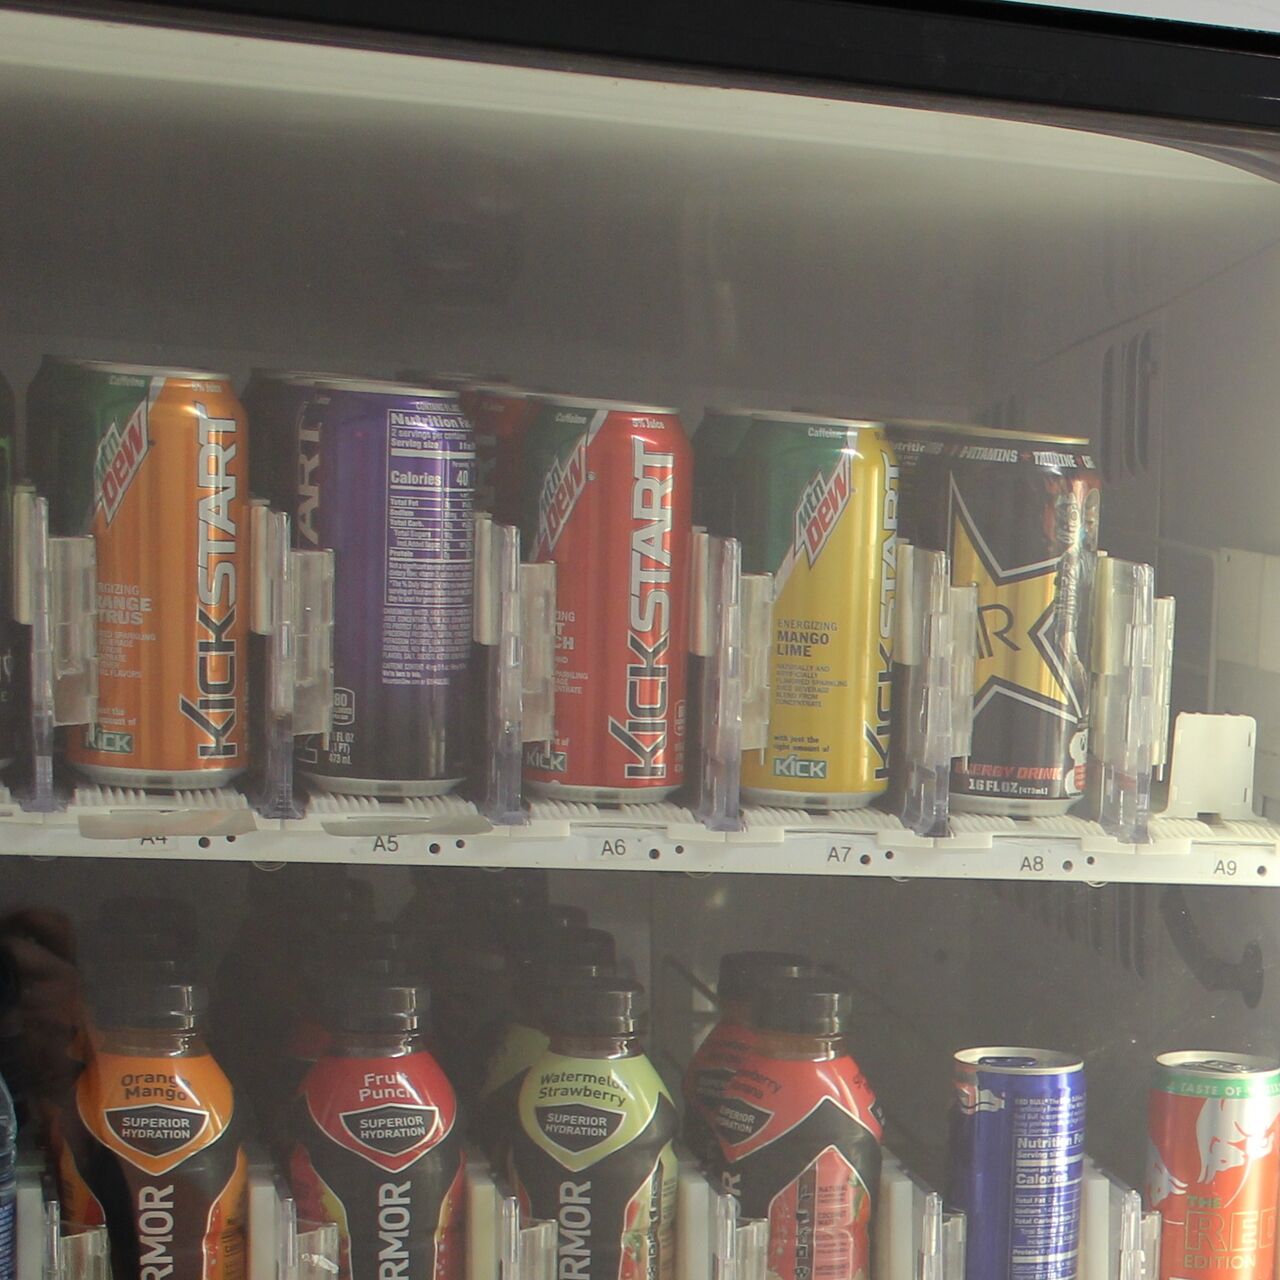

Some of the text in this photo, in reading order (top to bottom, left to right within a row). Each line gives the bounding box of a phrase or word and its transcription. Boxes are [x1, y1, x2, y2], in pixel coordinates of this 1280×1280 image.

[391, 412, 457, 429] Nutrition
[391, 437, 422, 449] Serving
[391, 470, 442, 486] Calories
[456, 470, 469, 486] 40
[179, 400, 238, 758] KICKSTART
[608, 434, 674, 779] KICKSTART
[777, 619, 838, 631] ENERGIZING
[777, 630, 830, 645] MANGO
[777, 645, 812, 657] LIME
[807, 736, 819, 744] the
[775, 754, 825, 778] KICK
[1018, 766, 1062, 781] DRINK
[968, 778, 985, 792] 16
[374, 834, 399, 852] A5
[601, 839, 626, 856] A6
[827, 846, 852, 864] A7
[1020, 854, 1044, 872] A8
[1213, 859, 1237, 876] A9
[121, 1073, 193, 1089] Orange
[125, 1086, 188, 1101] Mango
[538, 1086, 627, 1107] Strawberry
[1180, 1083, 1218, 1095] TASTE
[1225, 1086, 1243, 1096] OF
[122, 1117, 190, 1128] SUPERIOR
[360, 1116, 424, 1129] SUPERIOR
[547, 1113, 608, 1126] SUPERIOR
[122, 1129, 191, 1139] HYDRATION
[361, 1127, 426, 1139] HYDRATION
[545, 1125, 608, 1137] HYDRATION
[1016, 1173, 1068, 1185] Calories
[1187, 1195, 1221, 1208] THE
[1185, 1207, 1276, 1252] RED
[1184, 1255, 1256, 1269] EDITION
